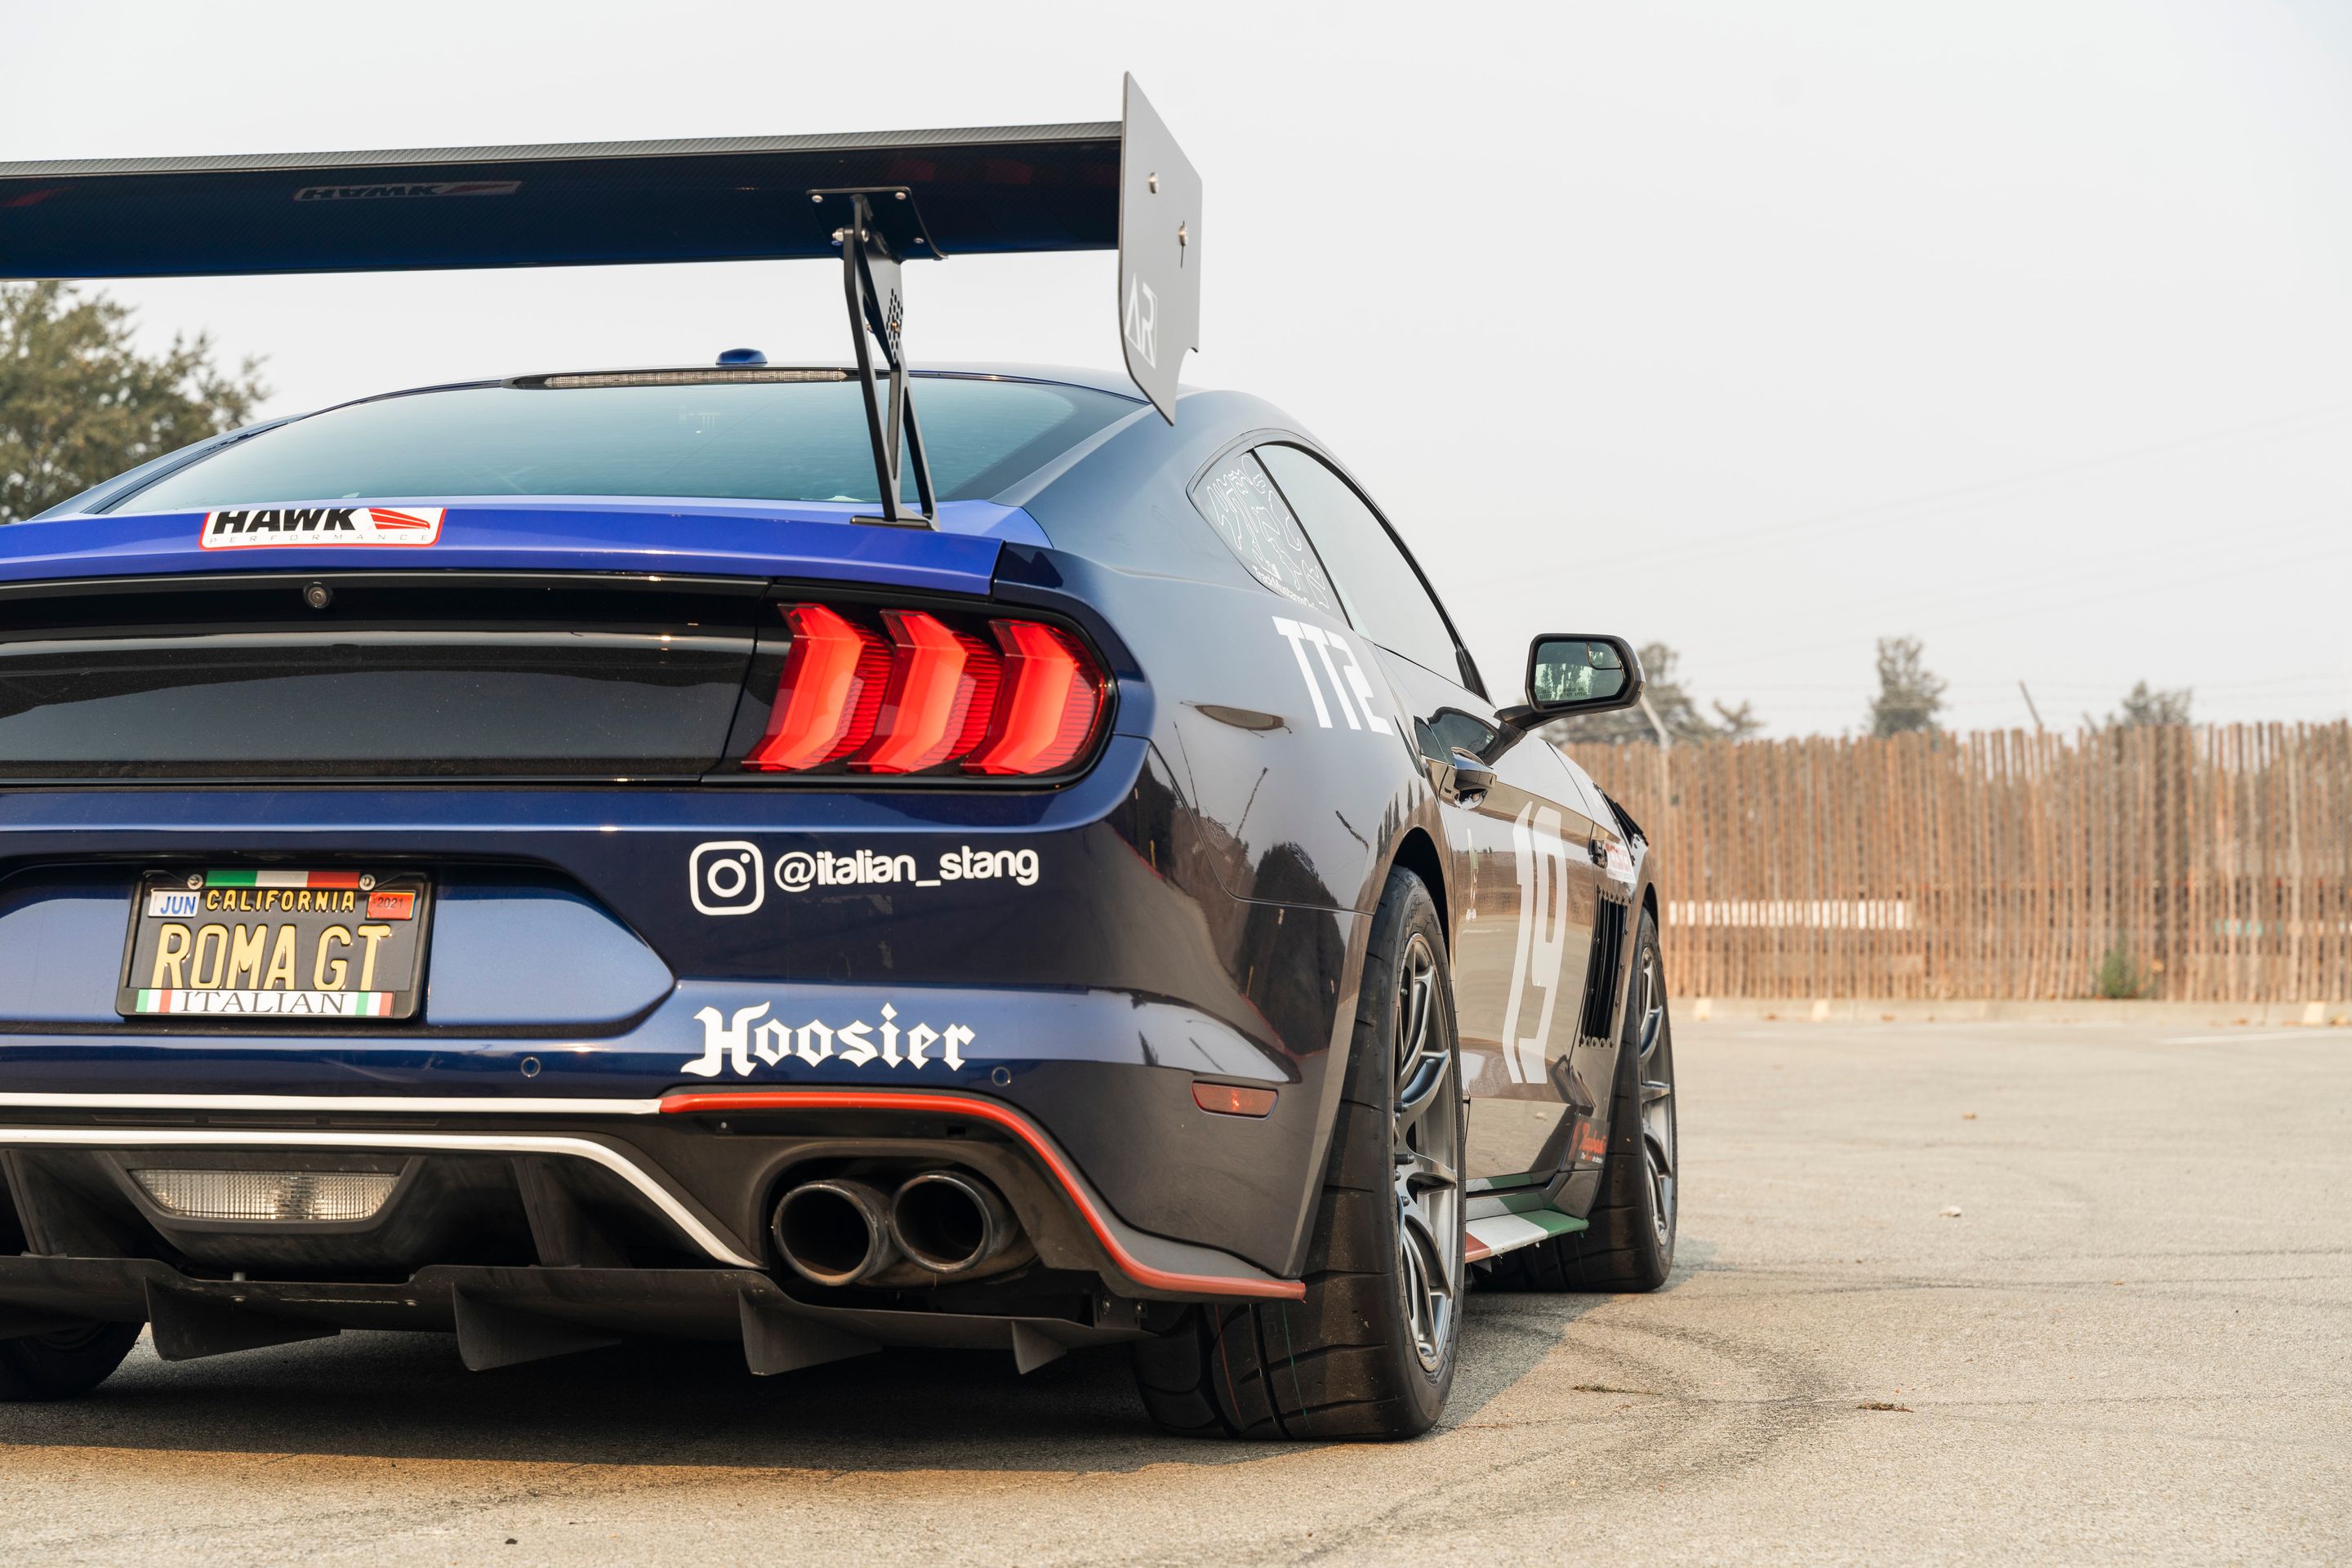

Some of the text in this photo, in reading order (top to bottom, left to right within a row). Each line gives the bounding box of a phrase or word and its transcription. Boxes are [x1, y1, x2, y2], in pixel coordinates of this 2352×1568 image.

[212, 508, 360, 535] HAWK
[210, 533, 428, 546] PERFORMANCE
[1272, 616, 1395, 737] TT2
[774, 845, 1039, 893] @italian_stang
[160, 896, 196, 915] JUN
[206, 889, 355, 912] CALIFORNIA
[377, 897, 403, 908] 2021
[1503, 801, 1567, 1085] 19
[149, 923, 392, 991] ROMA GT
[180, 990, 347, 1014] ITALIAN
[680, 1001, 976, 1077] Hoosier
